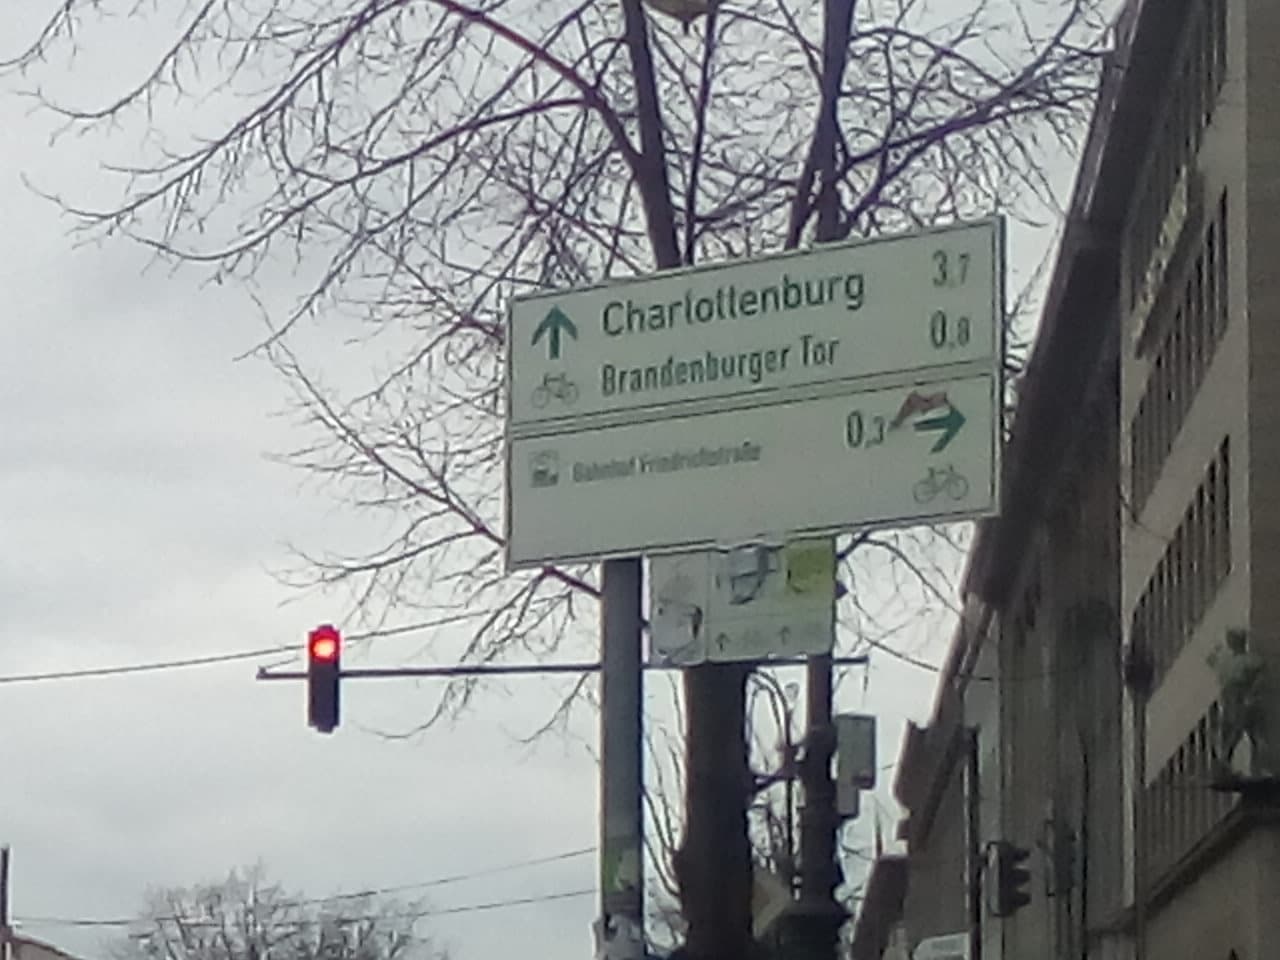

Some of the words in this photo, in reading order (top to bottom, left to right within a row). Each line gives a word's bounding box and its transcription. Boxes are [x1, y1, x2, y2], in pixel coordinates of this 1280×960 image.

[602, 272, 865, 337] Charlottenburg
[601, 344, 791, 396] Brandenburger
[799, 333, 840, 367] Tor
